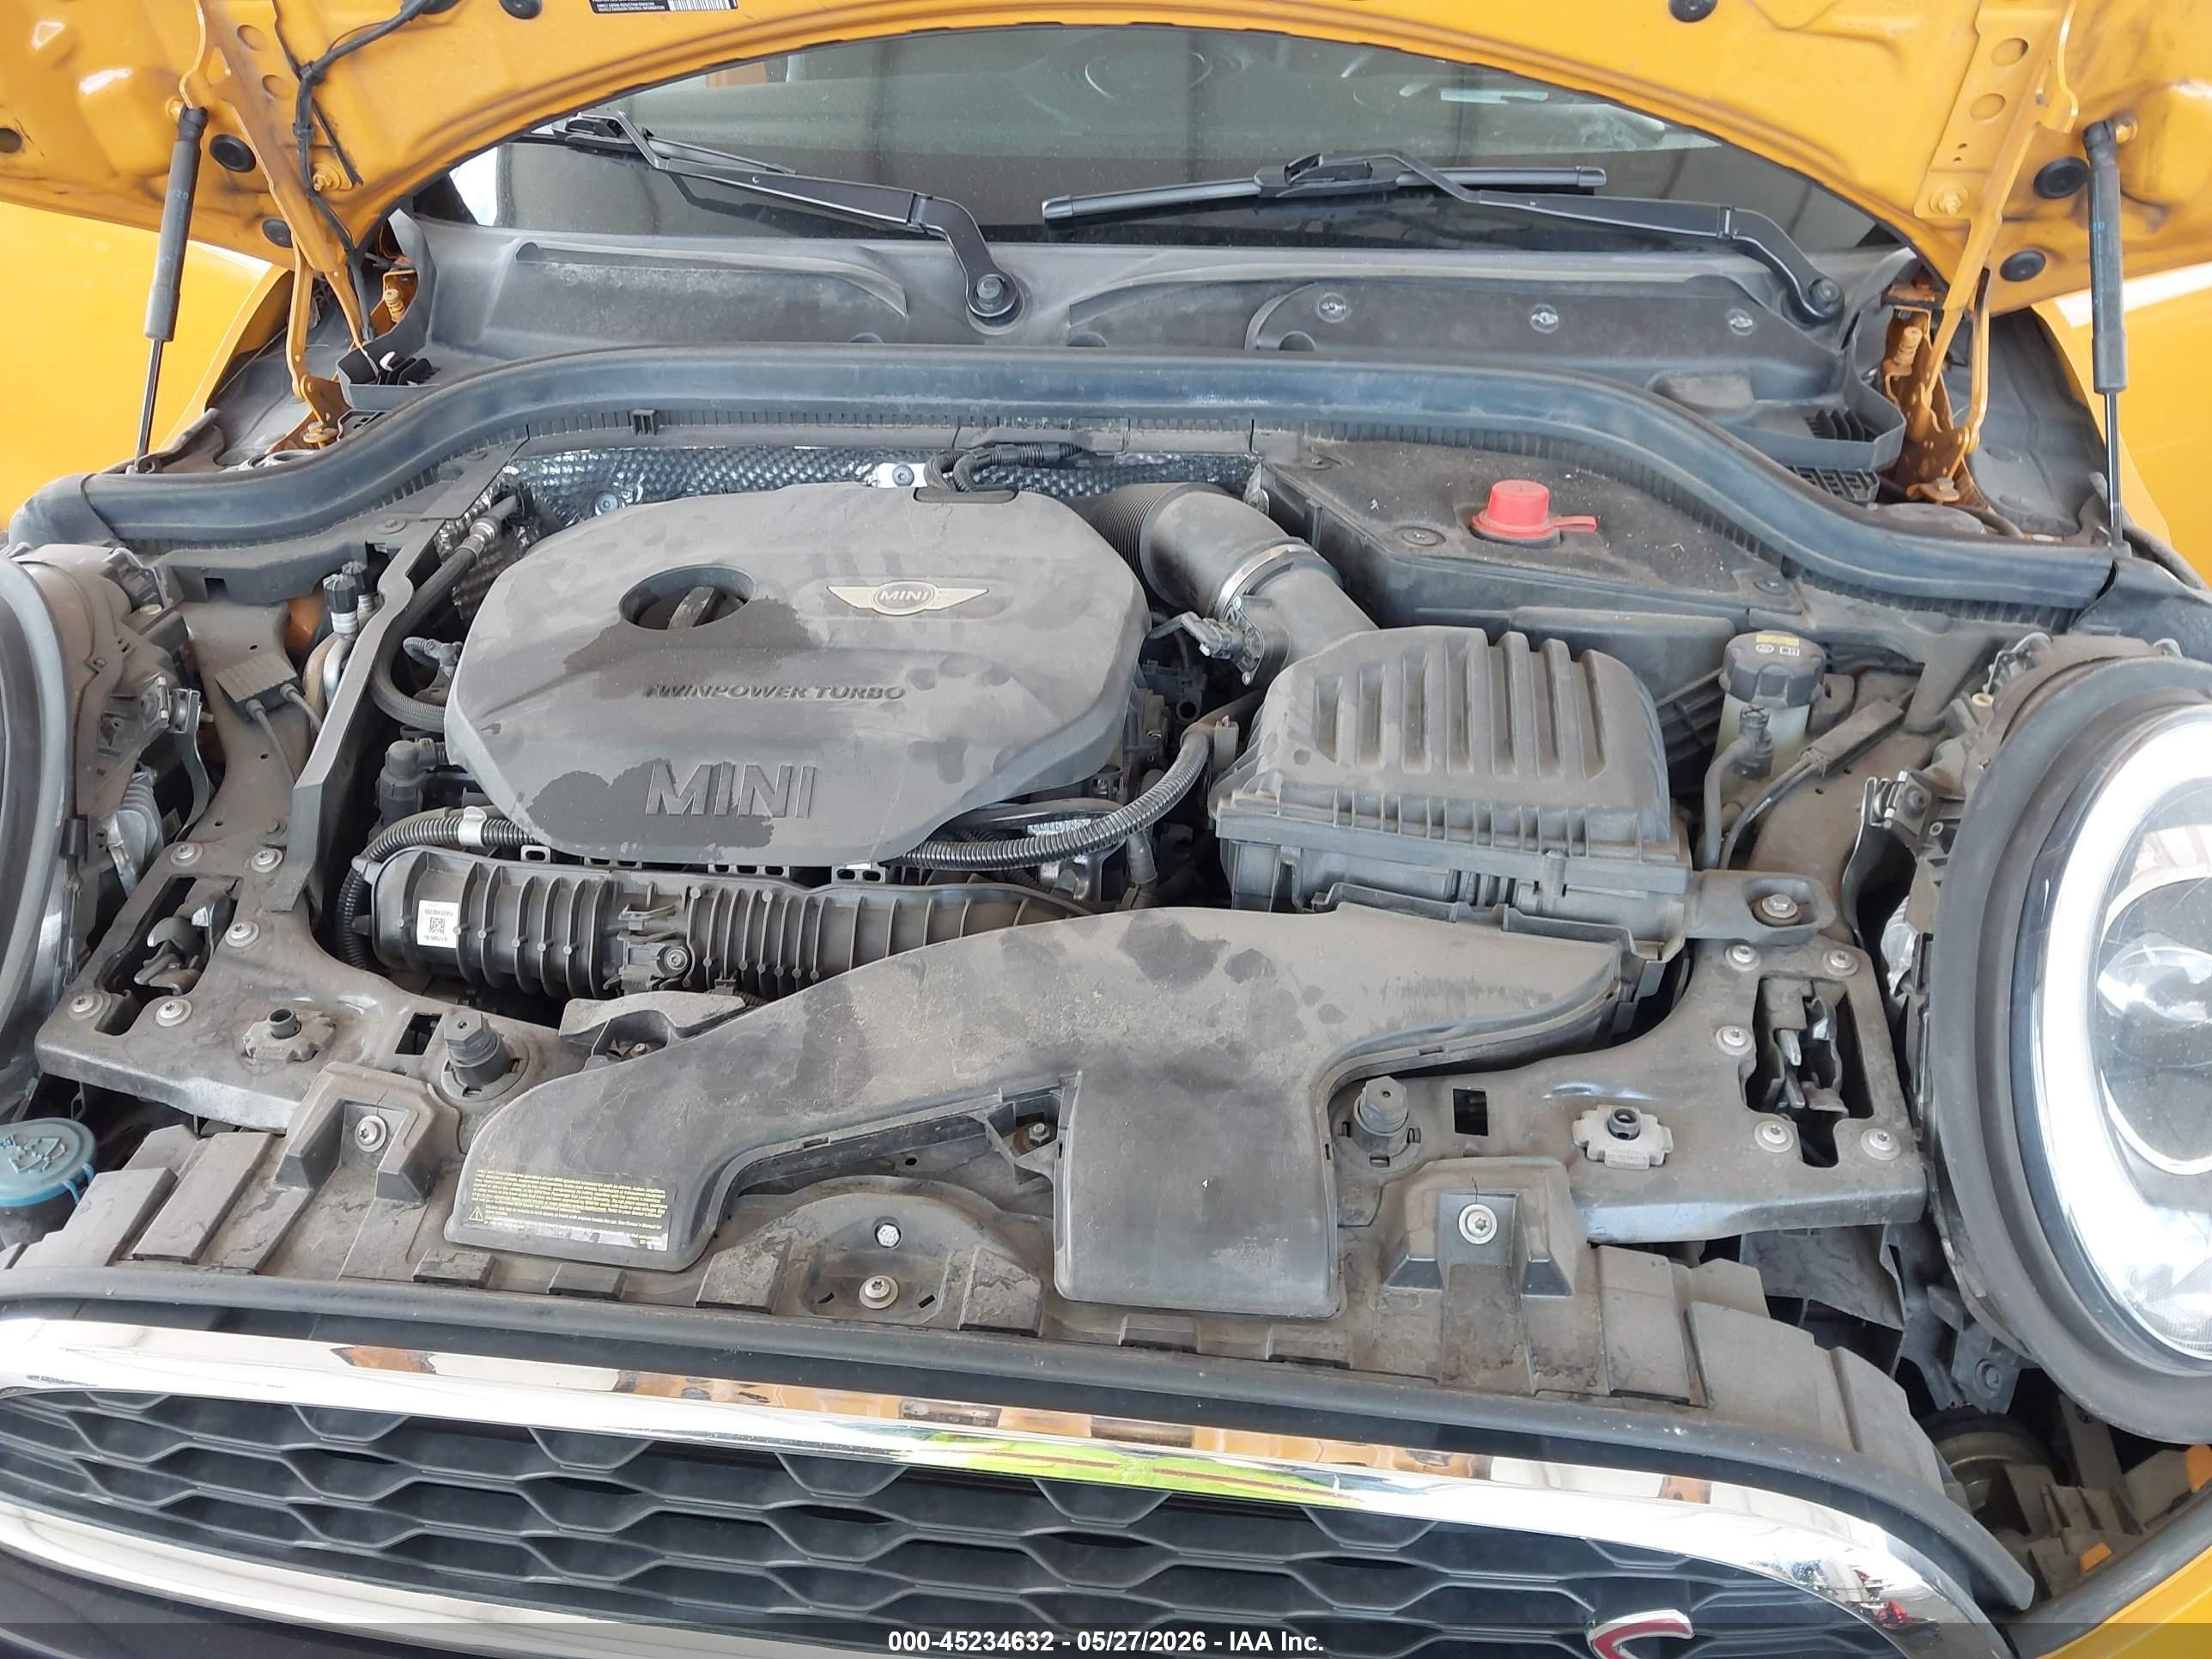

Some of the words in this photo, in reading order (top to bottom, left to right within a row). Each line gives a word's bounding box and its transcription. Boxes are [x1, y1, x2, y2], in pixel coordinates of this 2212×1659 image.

[879, 589, 929, 601] MINI
[645, 684, 806, 700] TWINPOWER
[816, 685, 906, 700] TURBO
[645, 763, 817, 818] MINI
